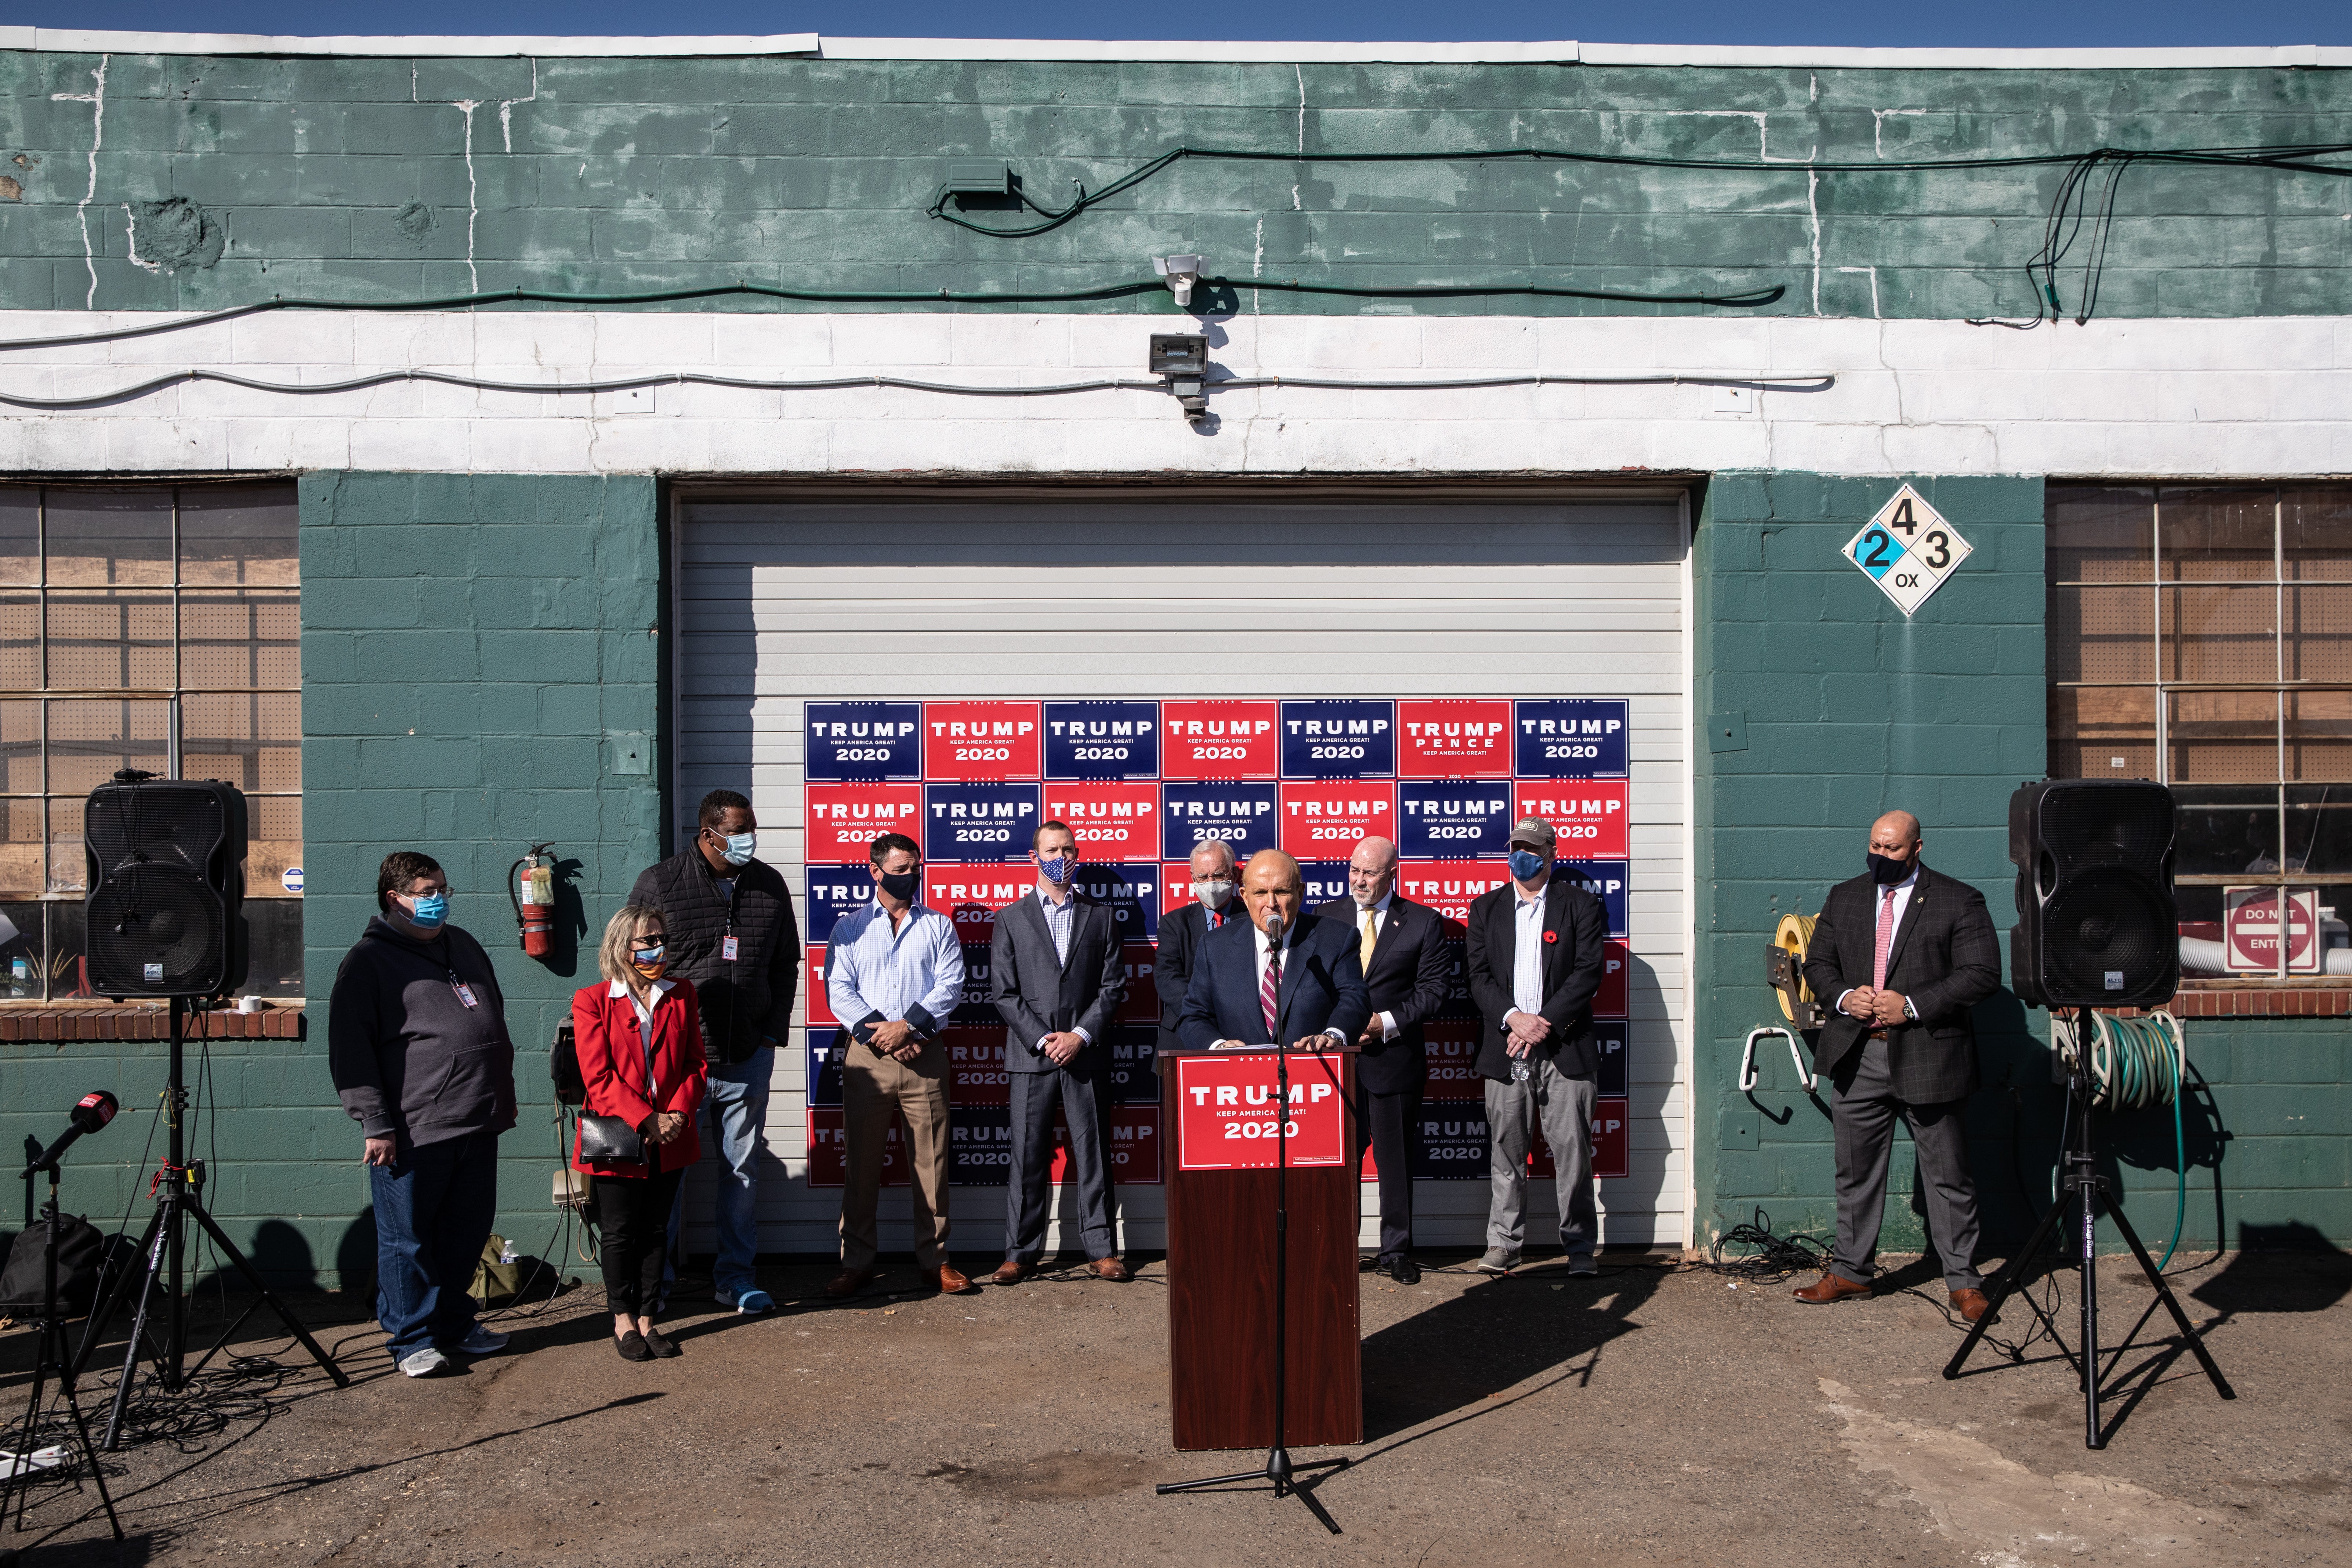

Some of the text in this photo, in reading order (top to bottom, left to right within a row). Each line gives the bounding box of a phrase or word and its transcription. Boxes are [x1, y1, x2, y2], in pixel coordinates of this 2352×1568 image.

[1891, 498, 1917, 536] 4
[1864, 529, 1890, 567] 2
[1926, 530, 1950, 569] 3
[1895, 573, 1918, 587] OX
[812, 723, 914, 736] TRUMP
[931, 722, 1033, 736] TRUMP
[1051, 721, 1152, 735] TRUMP
[1169, 721, 1270, 735] TRUMP
[1287, 720, 1388, 734] TRUMP
[1407, 723, 1502, 736] TRUMP
[1522, 720, 1620, 734] TRUMP
[1417, 739, 1493, 747] PENCE
[837, 749, 890, 761] 2020
[956, 748, 1009, 760] 2020
[1075, 747, 1128, 759] 2020
[1193, 747, 1246, 759] 2020
[1312, 746, 1364, 758] 2020
[1545, 746, 1597, 757] 2020
[813, 804, 914, 818] TRUMP
[932, 803, 1033, 817] TRUMP
[1051, 803, 1152, 816] TRUMP
[1169, 802, 1270, 816] TRUMP
[1287, 801, 1388, 815] TRUMP
[1405, 801, 1504, 814] TRUMP
[1522, 800, 1620, 814] TRUMP
[956, 829, 1010, 841] 2020
[1075, 829, 1128, 841] 2020
[1193, 828, 1246, 840] 2020
[1312, 827, 1364, 839] 2020
[1429, 826, 1481, 838] 2020
[813, 886, 877, 899] TRU
[956, 910, 995, 923] 202
[2246, 910, 2296, 919] DO NT
[957, 1072, 1010, 1084] 2020
[953, 1127, 1011, 1141] RUM
[1224, 1121, 1299, 1139] 2020
[1424, 1122, 1485, 1136] RUM
[958, 1153, 1011, 1165] 2020
[1429, 1148, 1482, 1159] 2020
